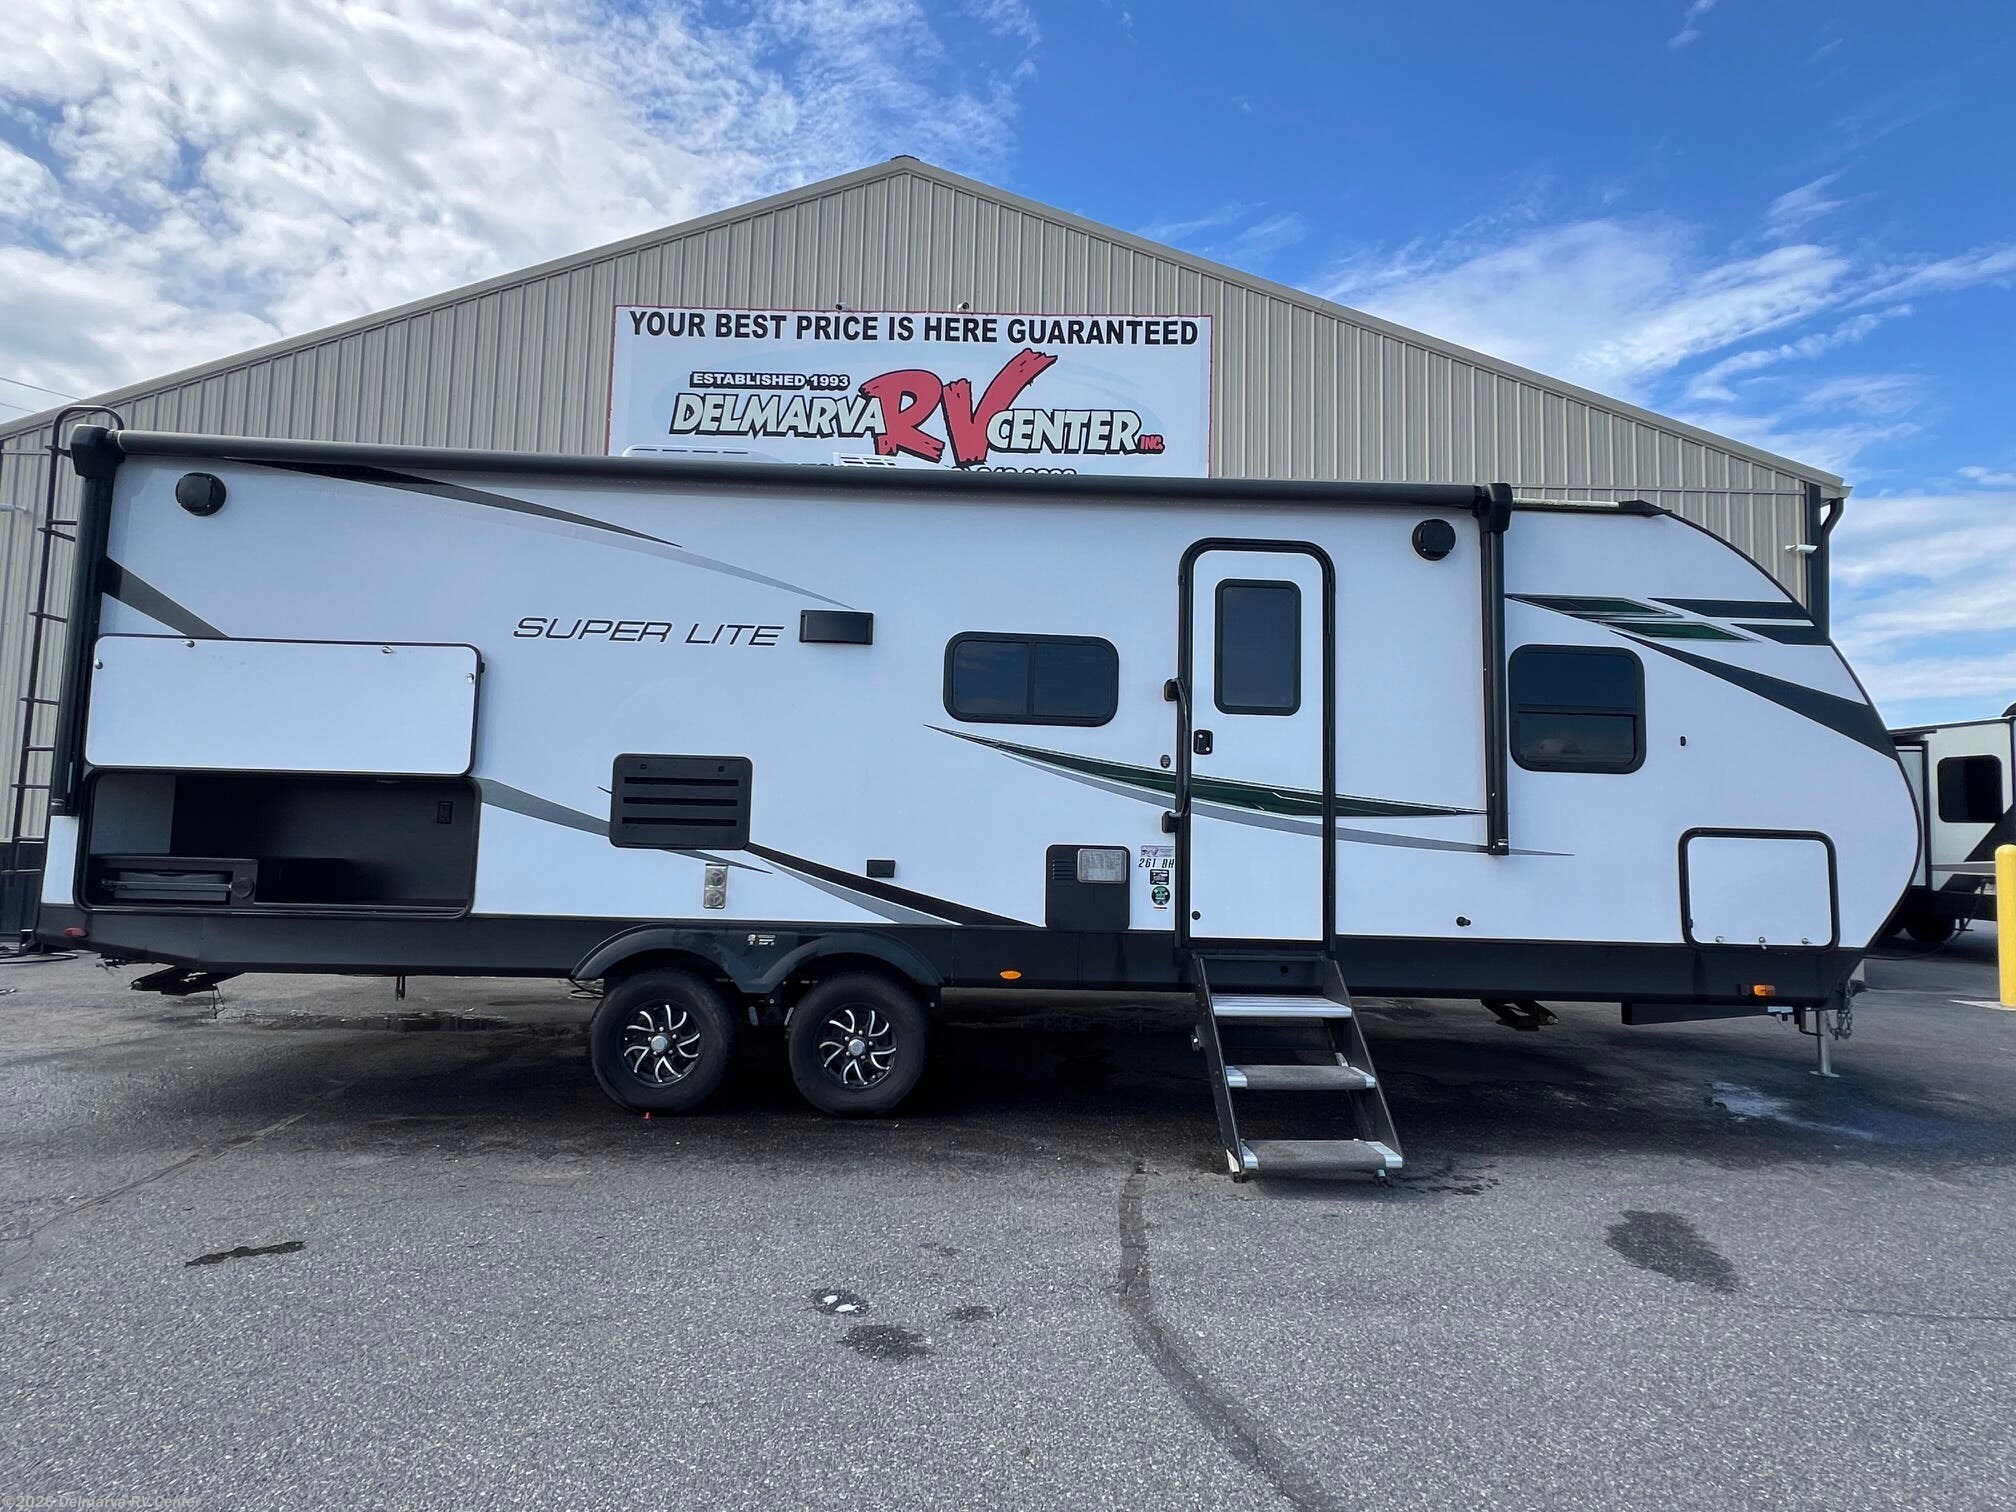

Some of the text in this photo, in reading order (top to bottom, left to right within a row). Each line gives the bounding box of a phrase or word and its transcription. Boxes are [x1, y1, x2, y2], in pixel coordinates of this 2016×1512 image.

[629, 311, 1198, 345] YOUR BEST PRICE IS HERE GUARANTEED
[690, 371, 850, 389] ESTABLISHED 1993
[670, 348, 1165, 466] DELMARVA RV CENTER INC.
[513, 616, 785, 647] SUPER LITE
